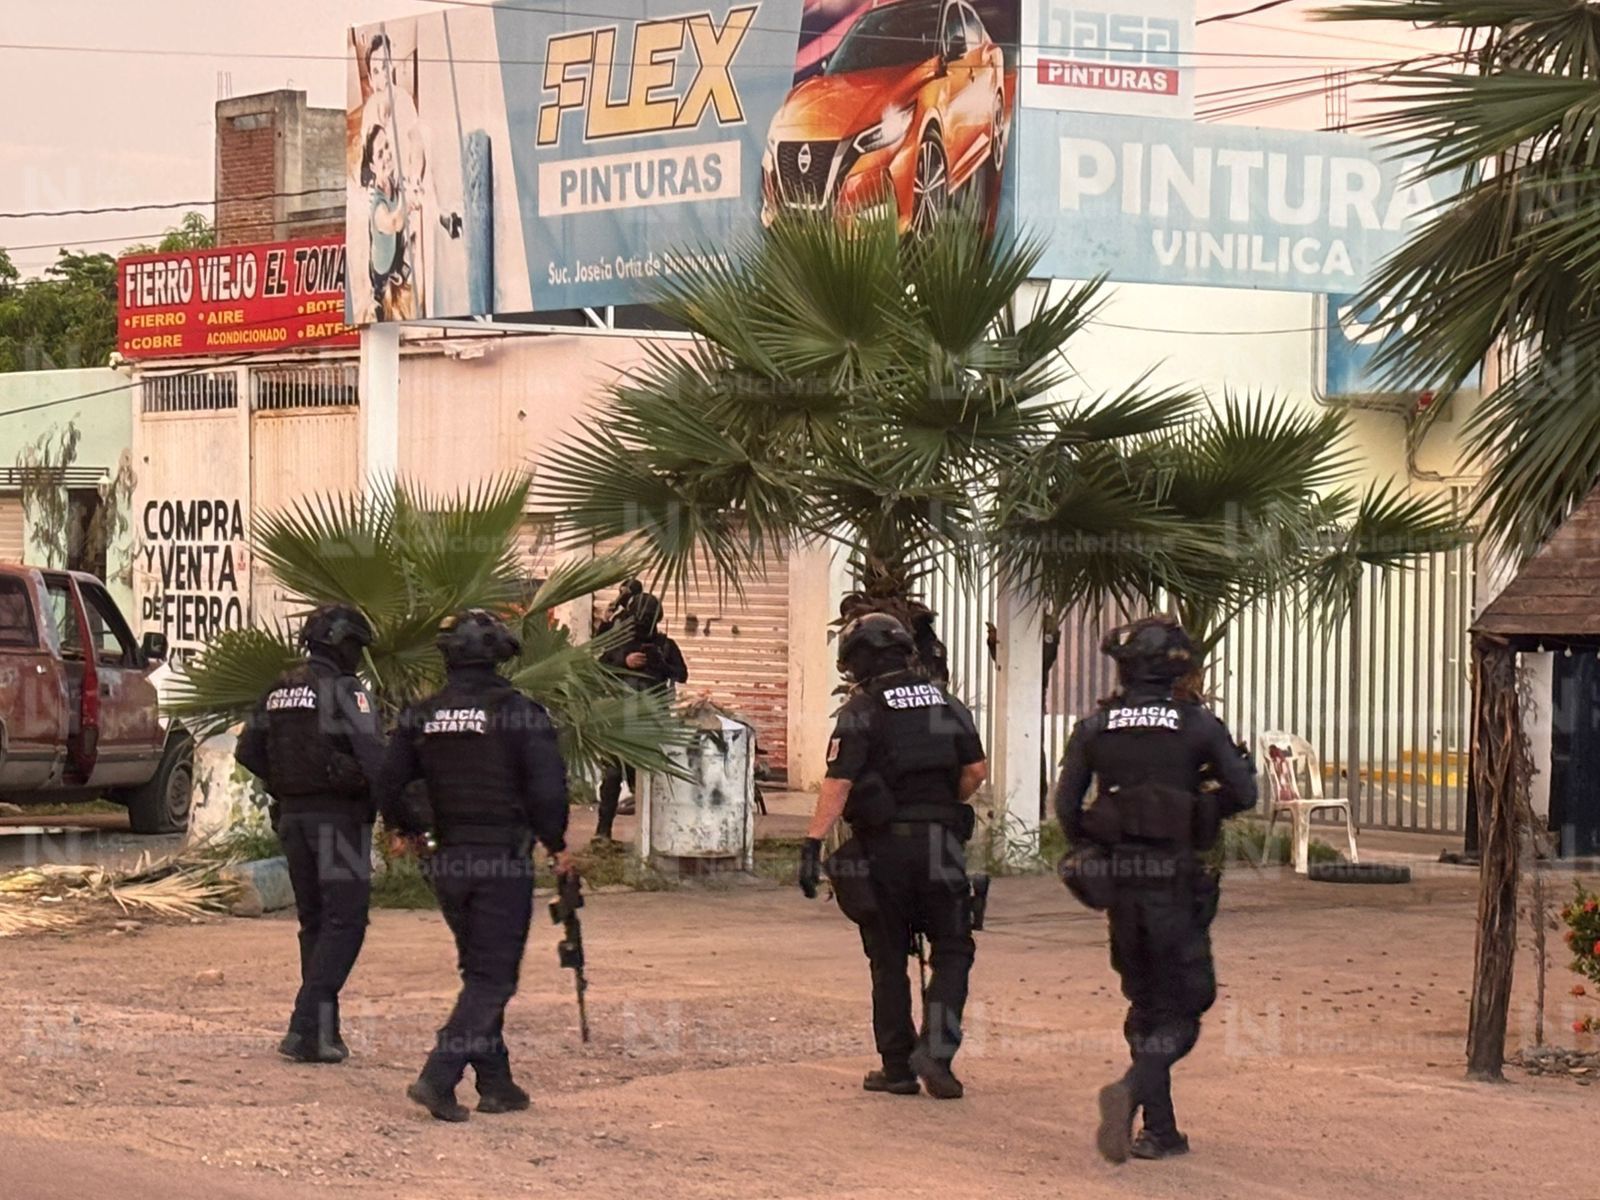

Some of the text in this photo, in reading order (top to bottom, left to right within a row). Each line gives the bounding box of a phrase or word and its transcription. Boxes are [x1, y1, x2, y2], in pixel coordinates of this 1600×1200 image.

[536, 2, 762, 149] FLEX
[1048, 63, 1168, 92] PINTURAS
[560, 152, 723, 207] PINTURAS
[1058, 136, 1441, 231] PINTURA
[548, 261, 572, 285] Suc.
[645, 251, 660, 277] de
[1152, 229, 1355, 277] VINILICA
[125, 258, 193, 309] FIERRO
[198, 252, 258, 304] VIEJO
[262, 249, 289, 298] EL
[131, 312, 186, 329] FIERRO
[207, 309, 244, 325] AIRE
[207, 327, 288, 346] ACONDICIONADO
[132, 335, 183, 350] COBRE
[143, 499, 245, 541] COMPRA
[144, 545, 239, 592] Y VENTA
[143, 595, 243, 641] DE FIERRO
[1107, 716, 1178, 730] ESTATAL
